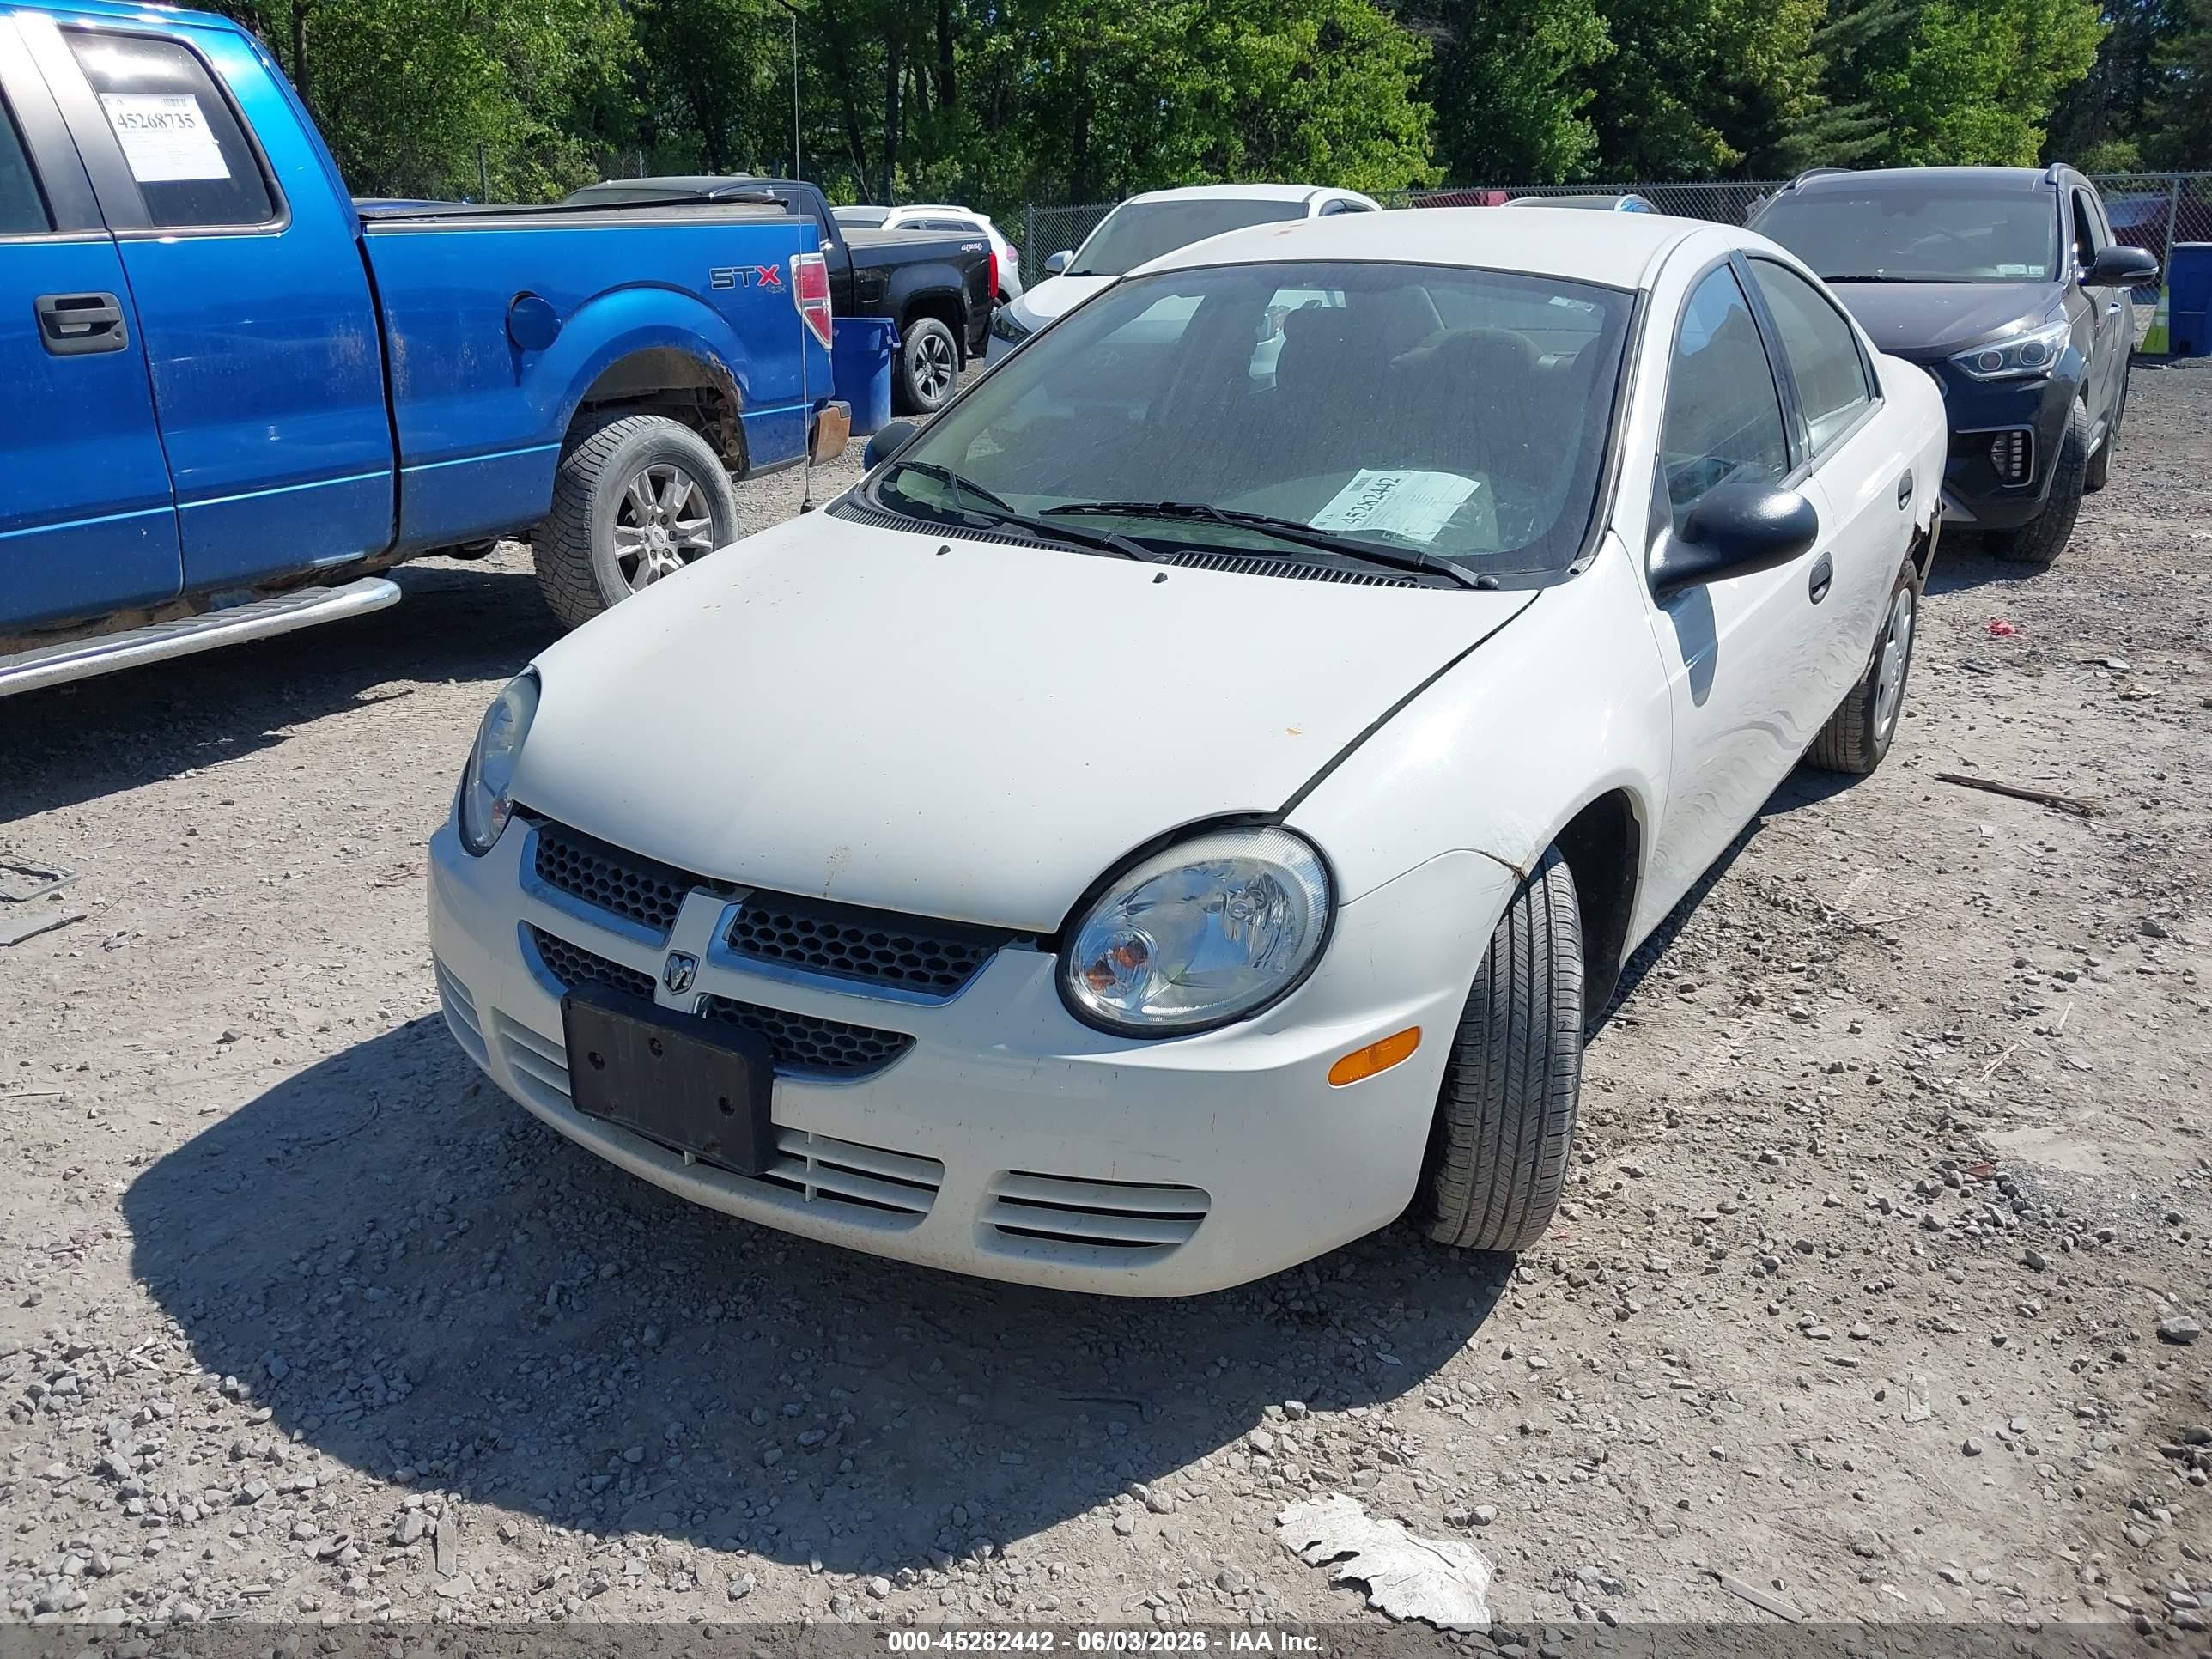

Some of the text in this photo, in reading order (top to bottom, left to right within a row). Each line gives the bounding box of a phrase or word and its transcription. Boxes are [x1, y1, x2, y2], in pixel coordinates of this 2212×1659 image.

[118, 112, 197, 129] 45268735
[708, 264, 782, 289] STX
[1340, 477, 1401, 524] 45282442
